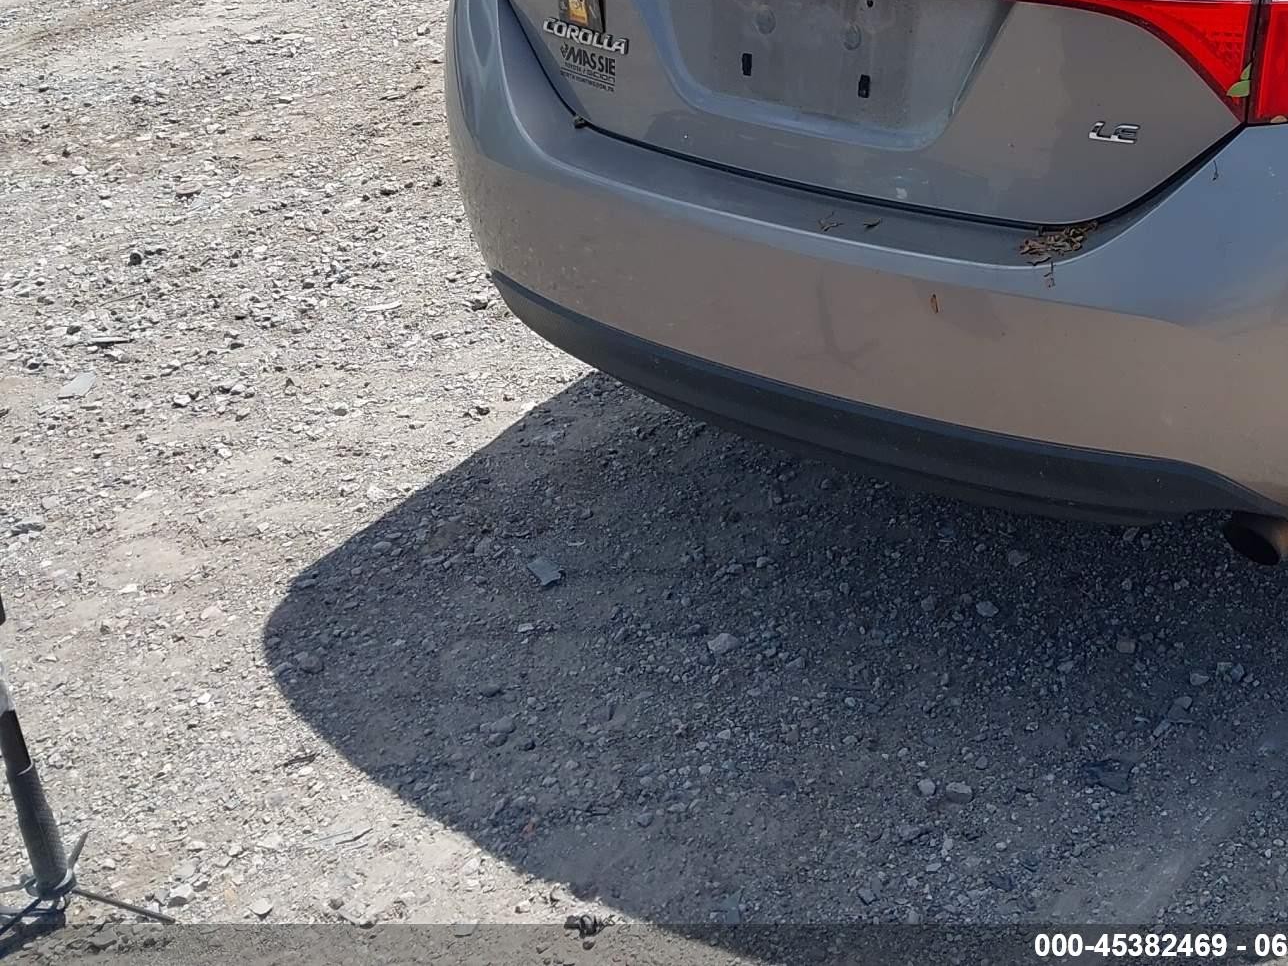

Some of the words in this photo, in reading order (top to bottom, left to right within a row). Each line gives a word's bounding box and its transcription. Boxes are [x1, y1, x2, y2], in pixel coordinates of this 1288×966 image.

[543, 17, 629, 55] COROLLA
[566, 46, 616, 76] MASSIE
[1088, 121, 1141, 145] LE
